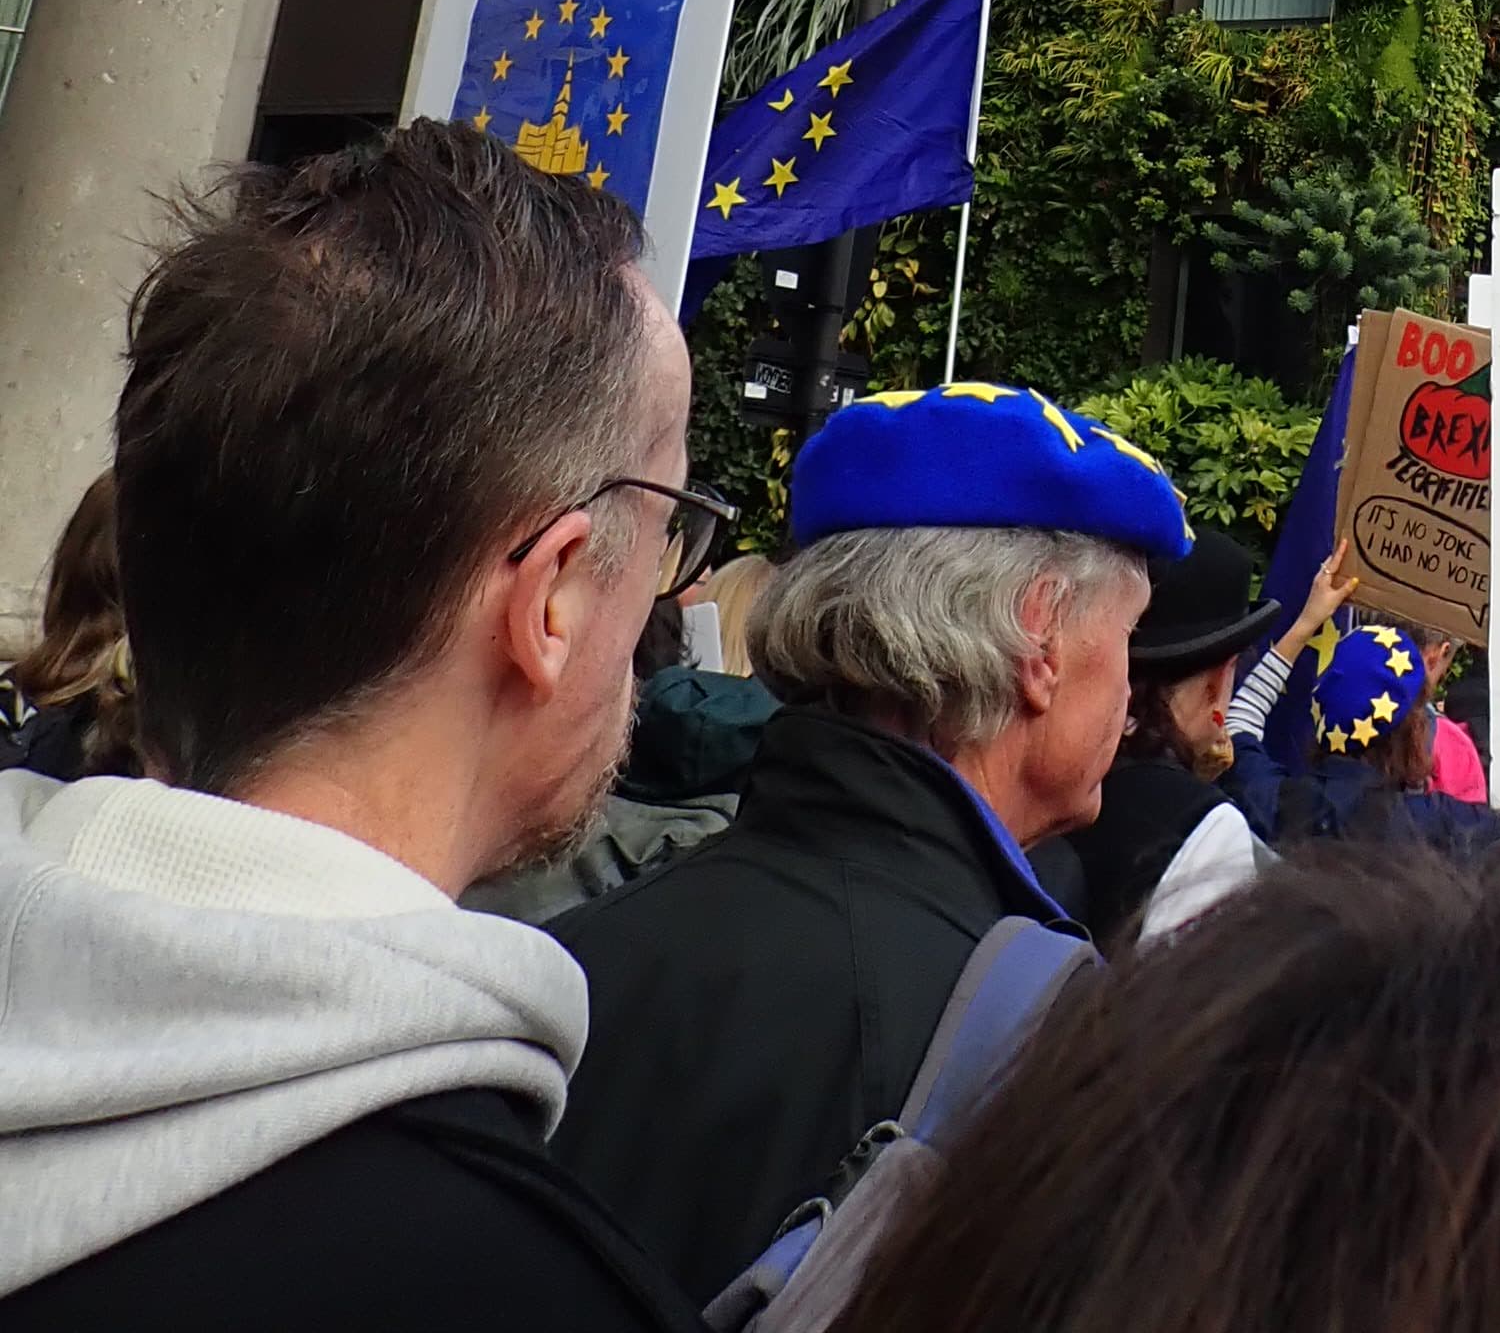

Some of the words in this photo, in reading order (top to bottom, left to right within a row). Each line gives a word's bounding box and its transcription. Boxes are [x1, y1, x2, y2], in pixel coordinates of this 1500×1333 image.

[1396, 321, 1475, 380] BOO
[1409, 402, 1490, 467] BREXI
[1367, 532, 1375, 550] I
[1380, 537, 1413, 563] HAD
[1417, 551, 1440, 572] NO
[1448, 561, 1488, 592] VOTE
[1368, 504, 1399, 531] IT'S
[1402, 518, 1427, 540] NO
[1432, 528, 1476, 561] JOKE
